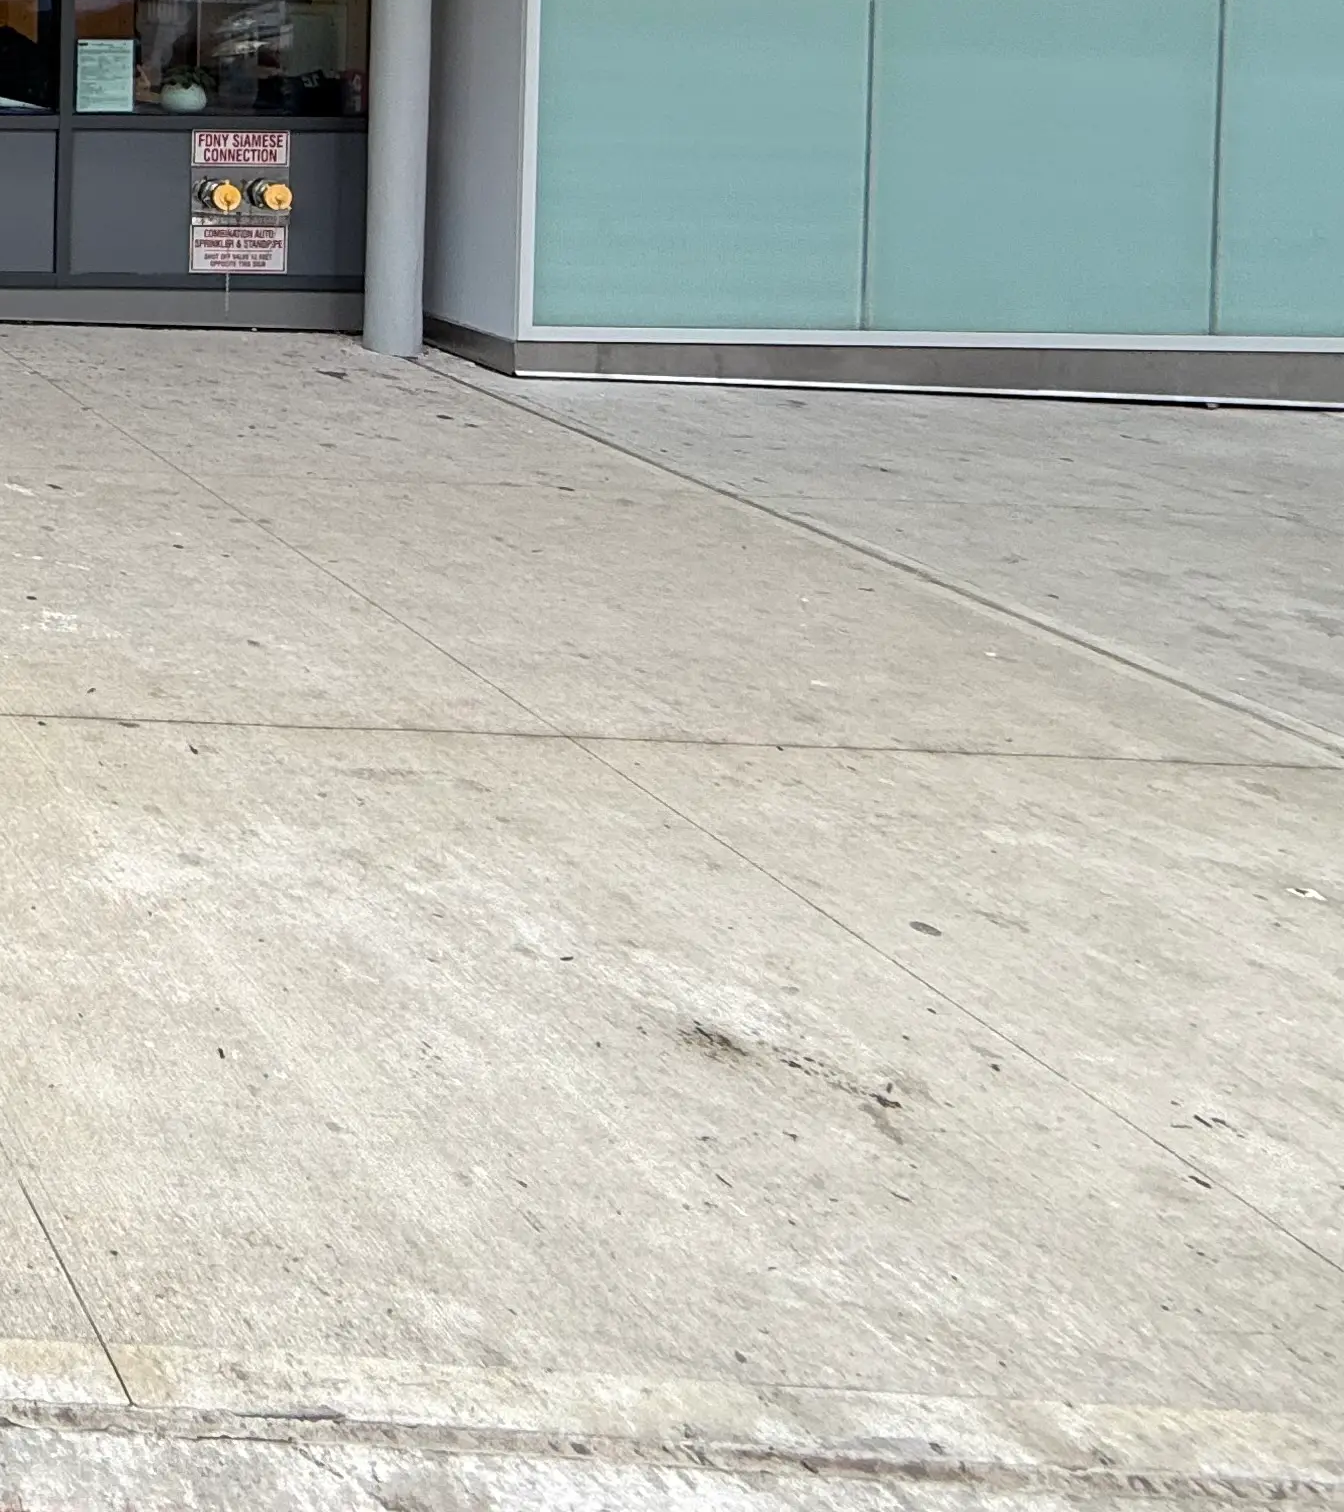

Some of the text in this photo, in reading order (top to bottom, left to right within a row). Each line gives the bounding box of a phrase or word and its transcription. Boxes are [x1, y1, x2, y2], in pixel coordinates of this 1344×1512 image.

[198, 134, 284, 148] FDNY SIAMESE
[203, 148, 278, 162] CONNECTION
[204, 229, 253, 238] COMBINATION
[194, 239, 234, 248] SPRINKLER
[243, 239, 283, 249] STANDPIPE
